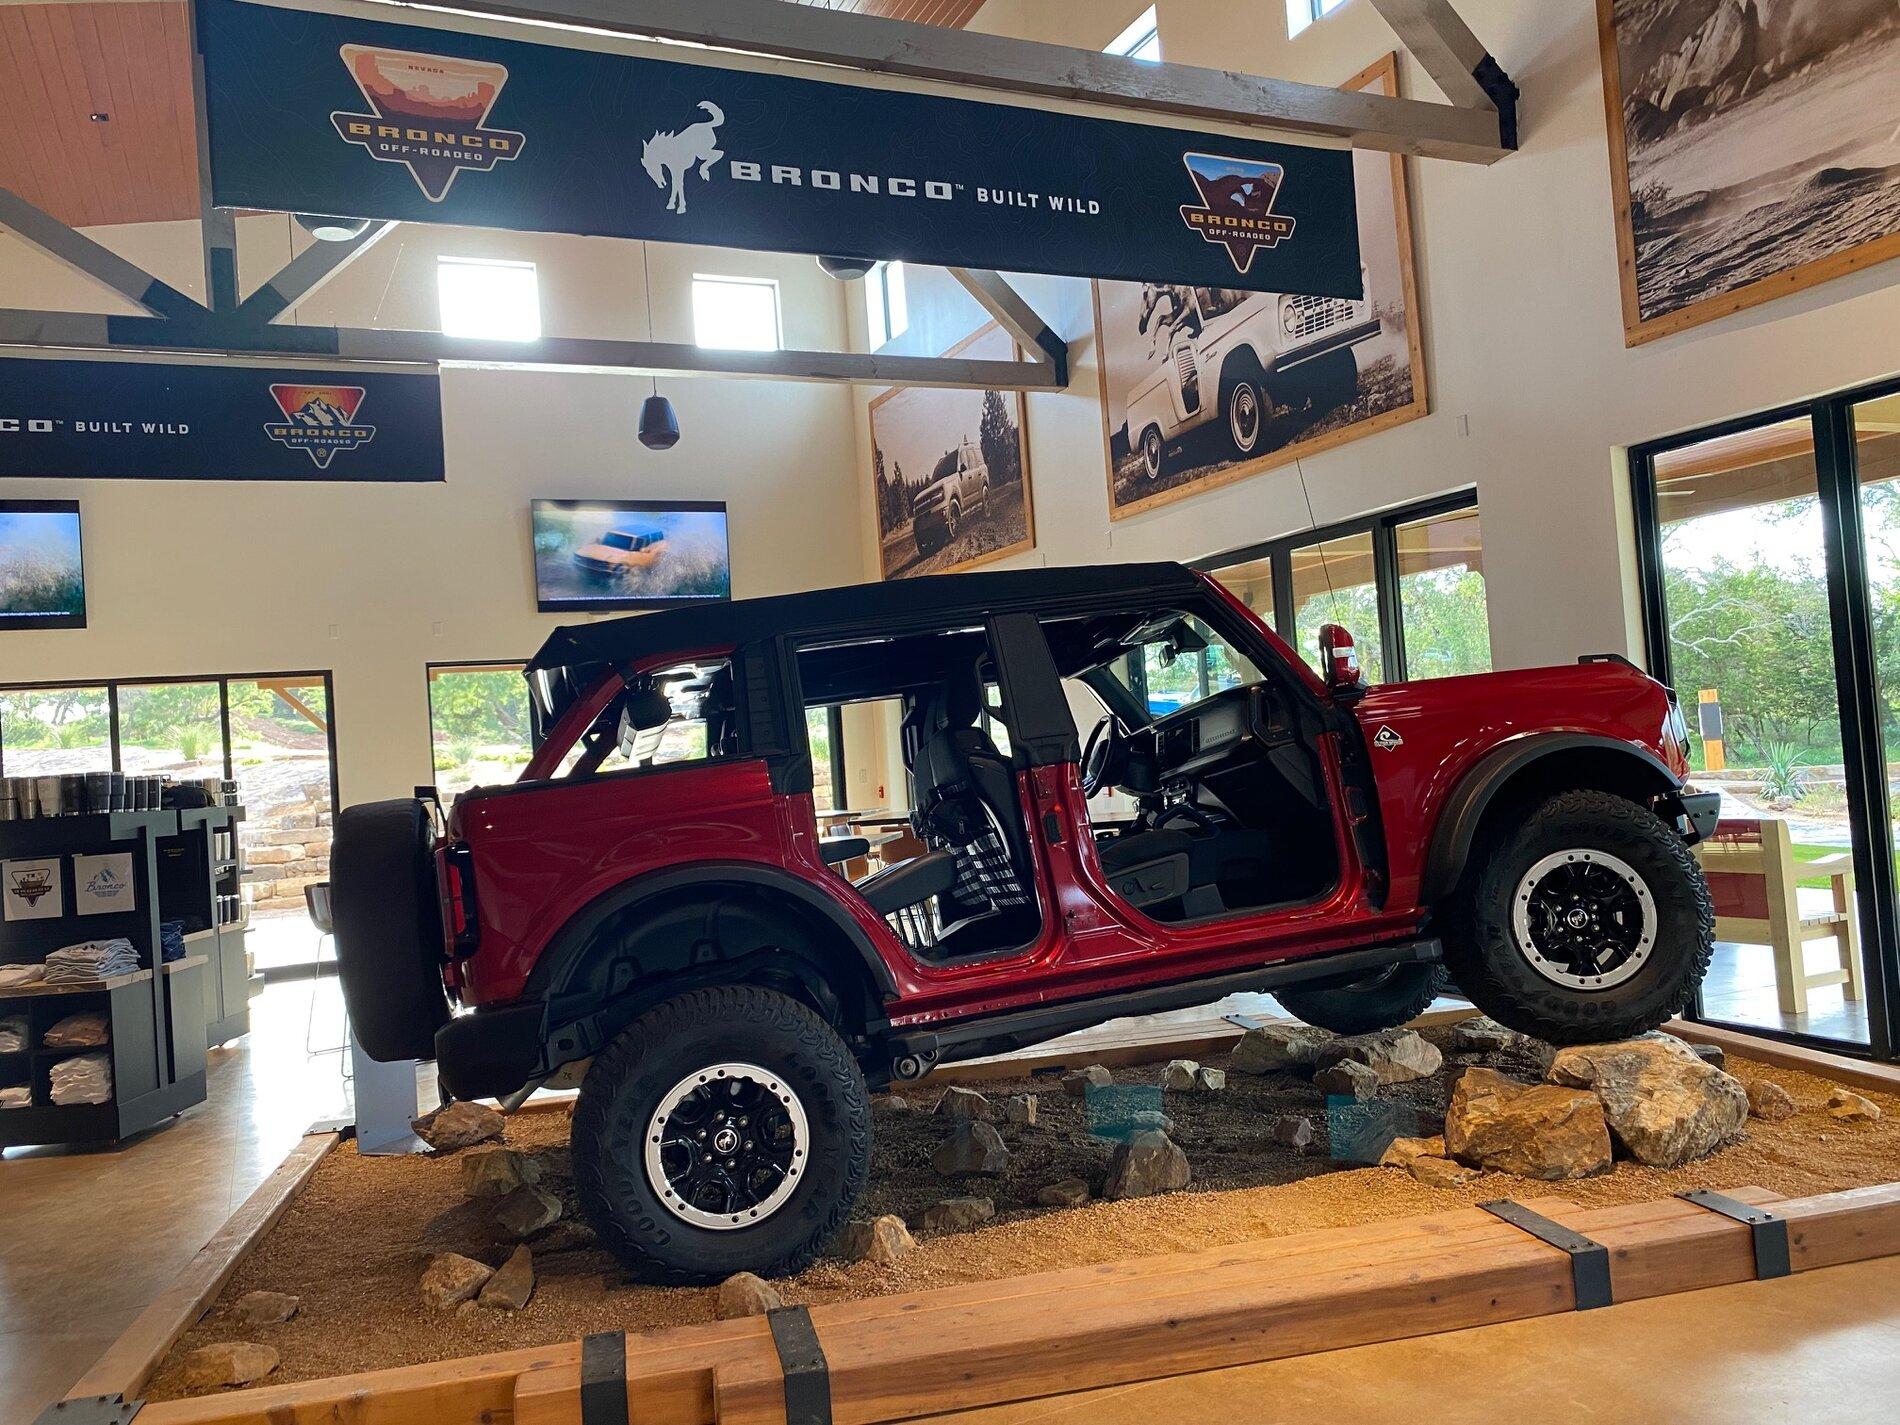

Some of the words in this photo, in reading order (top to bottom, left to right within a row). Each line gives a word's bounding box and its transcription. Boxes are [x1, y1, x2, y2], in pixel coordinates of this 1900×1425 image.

[408, 64, 445, 74] NEVADA
[349, 122, 509, 150] BRONCO
[380, 143, 483, 161] OFF-ROADEO
[977, 187, 1039, 208] BUILT
[1049, 195, 1100, 215] WILD
[1190, 213, 1287, 231] BRONCO
[1208, 228, 1271, 241] OFF-ROADEO
[75, 421, 132, 433] BUILT
[141, 423, 189, 434] WILD
[274, 428, 367, 437] BRONCO
